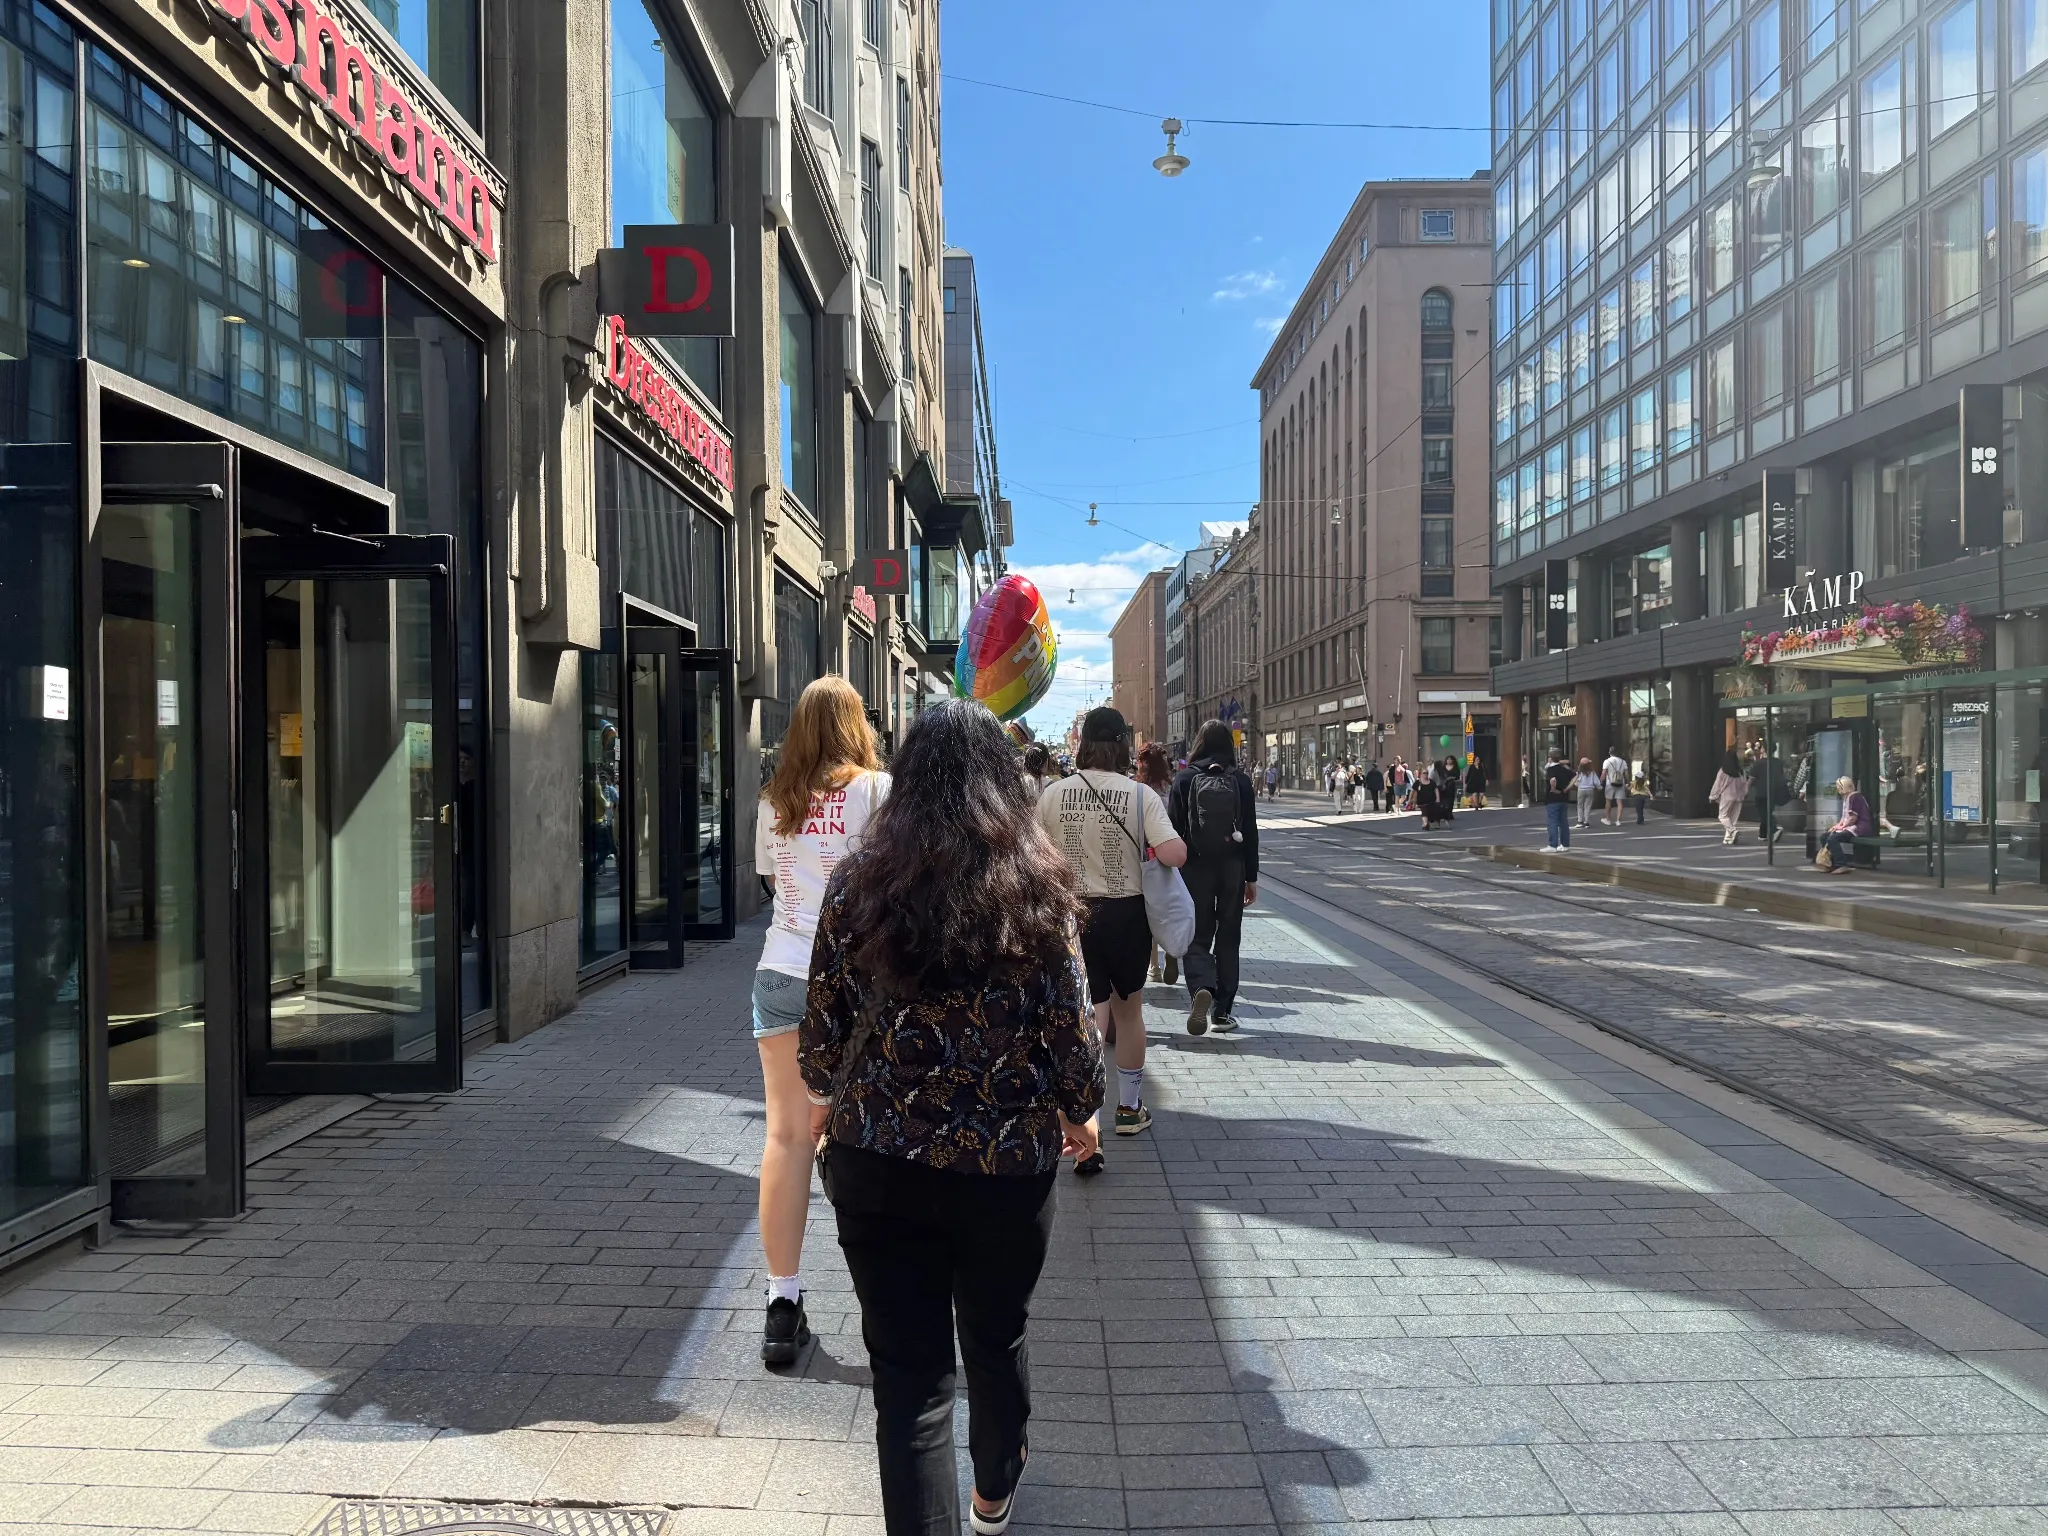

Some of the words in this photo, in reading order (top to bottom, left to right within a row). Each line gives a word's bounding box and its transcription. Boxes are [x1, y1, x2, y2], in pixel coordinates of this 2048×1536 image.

[608, 315, 734, 492] Dressmann
[872, 558, 902, 587] D
[1788, 617, 1852, 635] GALLERI
[1818, 640, 1847, 652] CENTRE
[1061, 788, 1099, 804] TAYLOR
[1100, 789, 1131, 806] SWIFT
[829, 805, 844, 819] IT
[1060, 802, 1078, 811] THE
[1059, 812, 1086, 823] 2023
